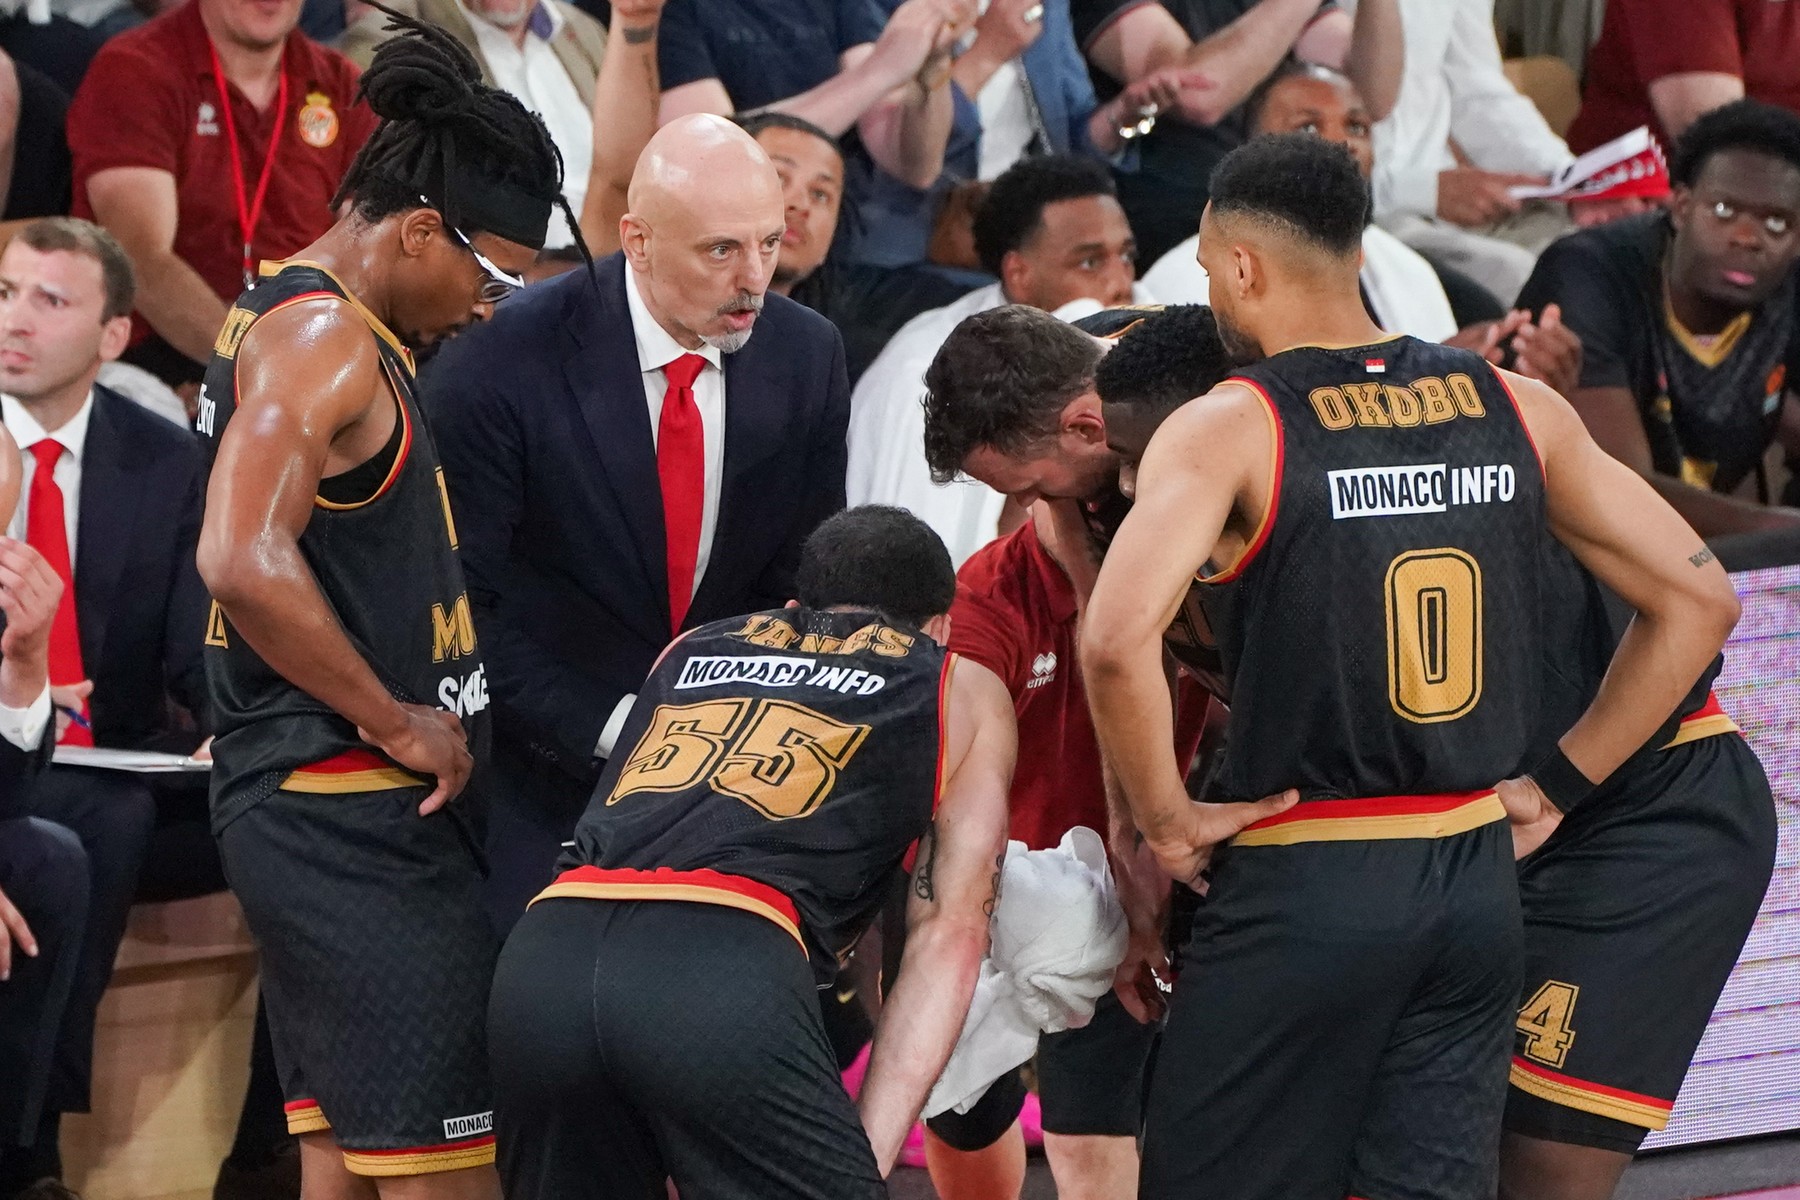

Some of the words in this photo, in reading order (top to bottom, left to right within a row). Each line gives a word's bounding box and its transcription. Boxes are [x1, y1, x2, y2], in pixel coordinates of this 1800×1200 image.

[1308, 372, 1486, 431] OKOBO
[1336, 470, 1447, 512] MONACO
[1451, 463, 1516, 506] INFO
[1384, 546, 1483, 724] 0
[682, 659, 813, 685] MONACO
[805, 666, 886, 695] INFO
[605, 697, 872, 822] 55
[1515, 980, 1580, 1069] 4
[446, 1113, 494, 1136] MONACO
